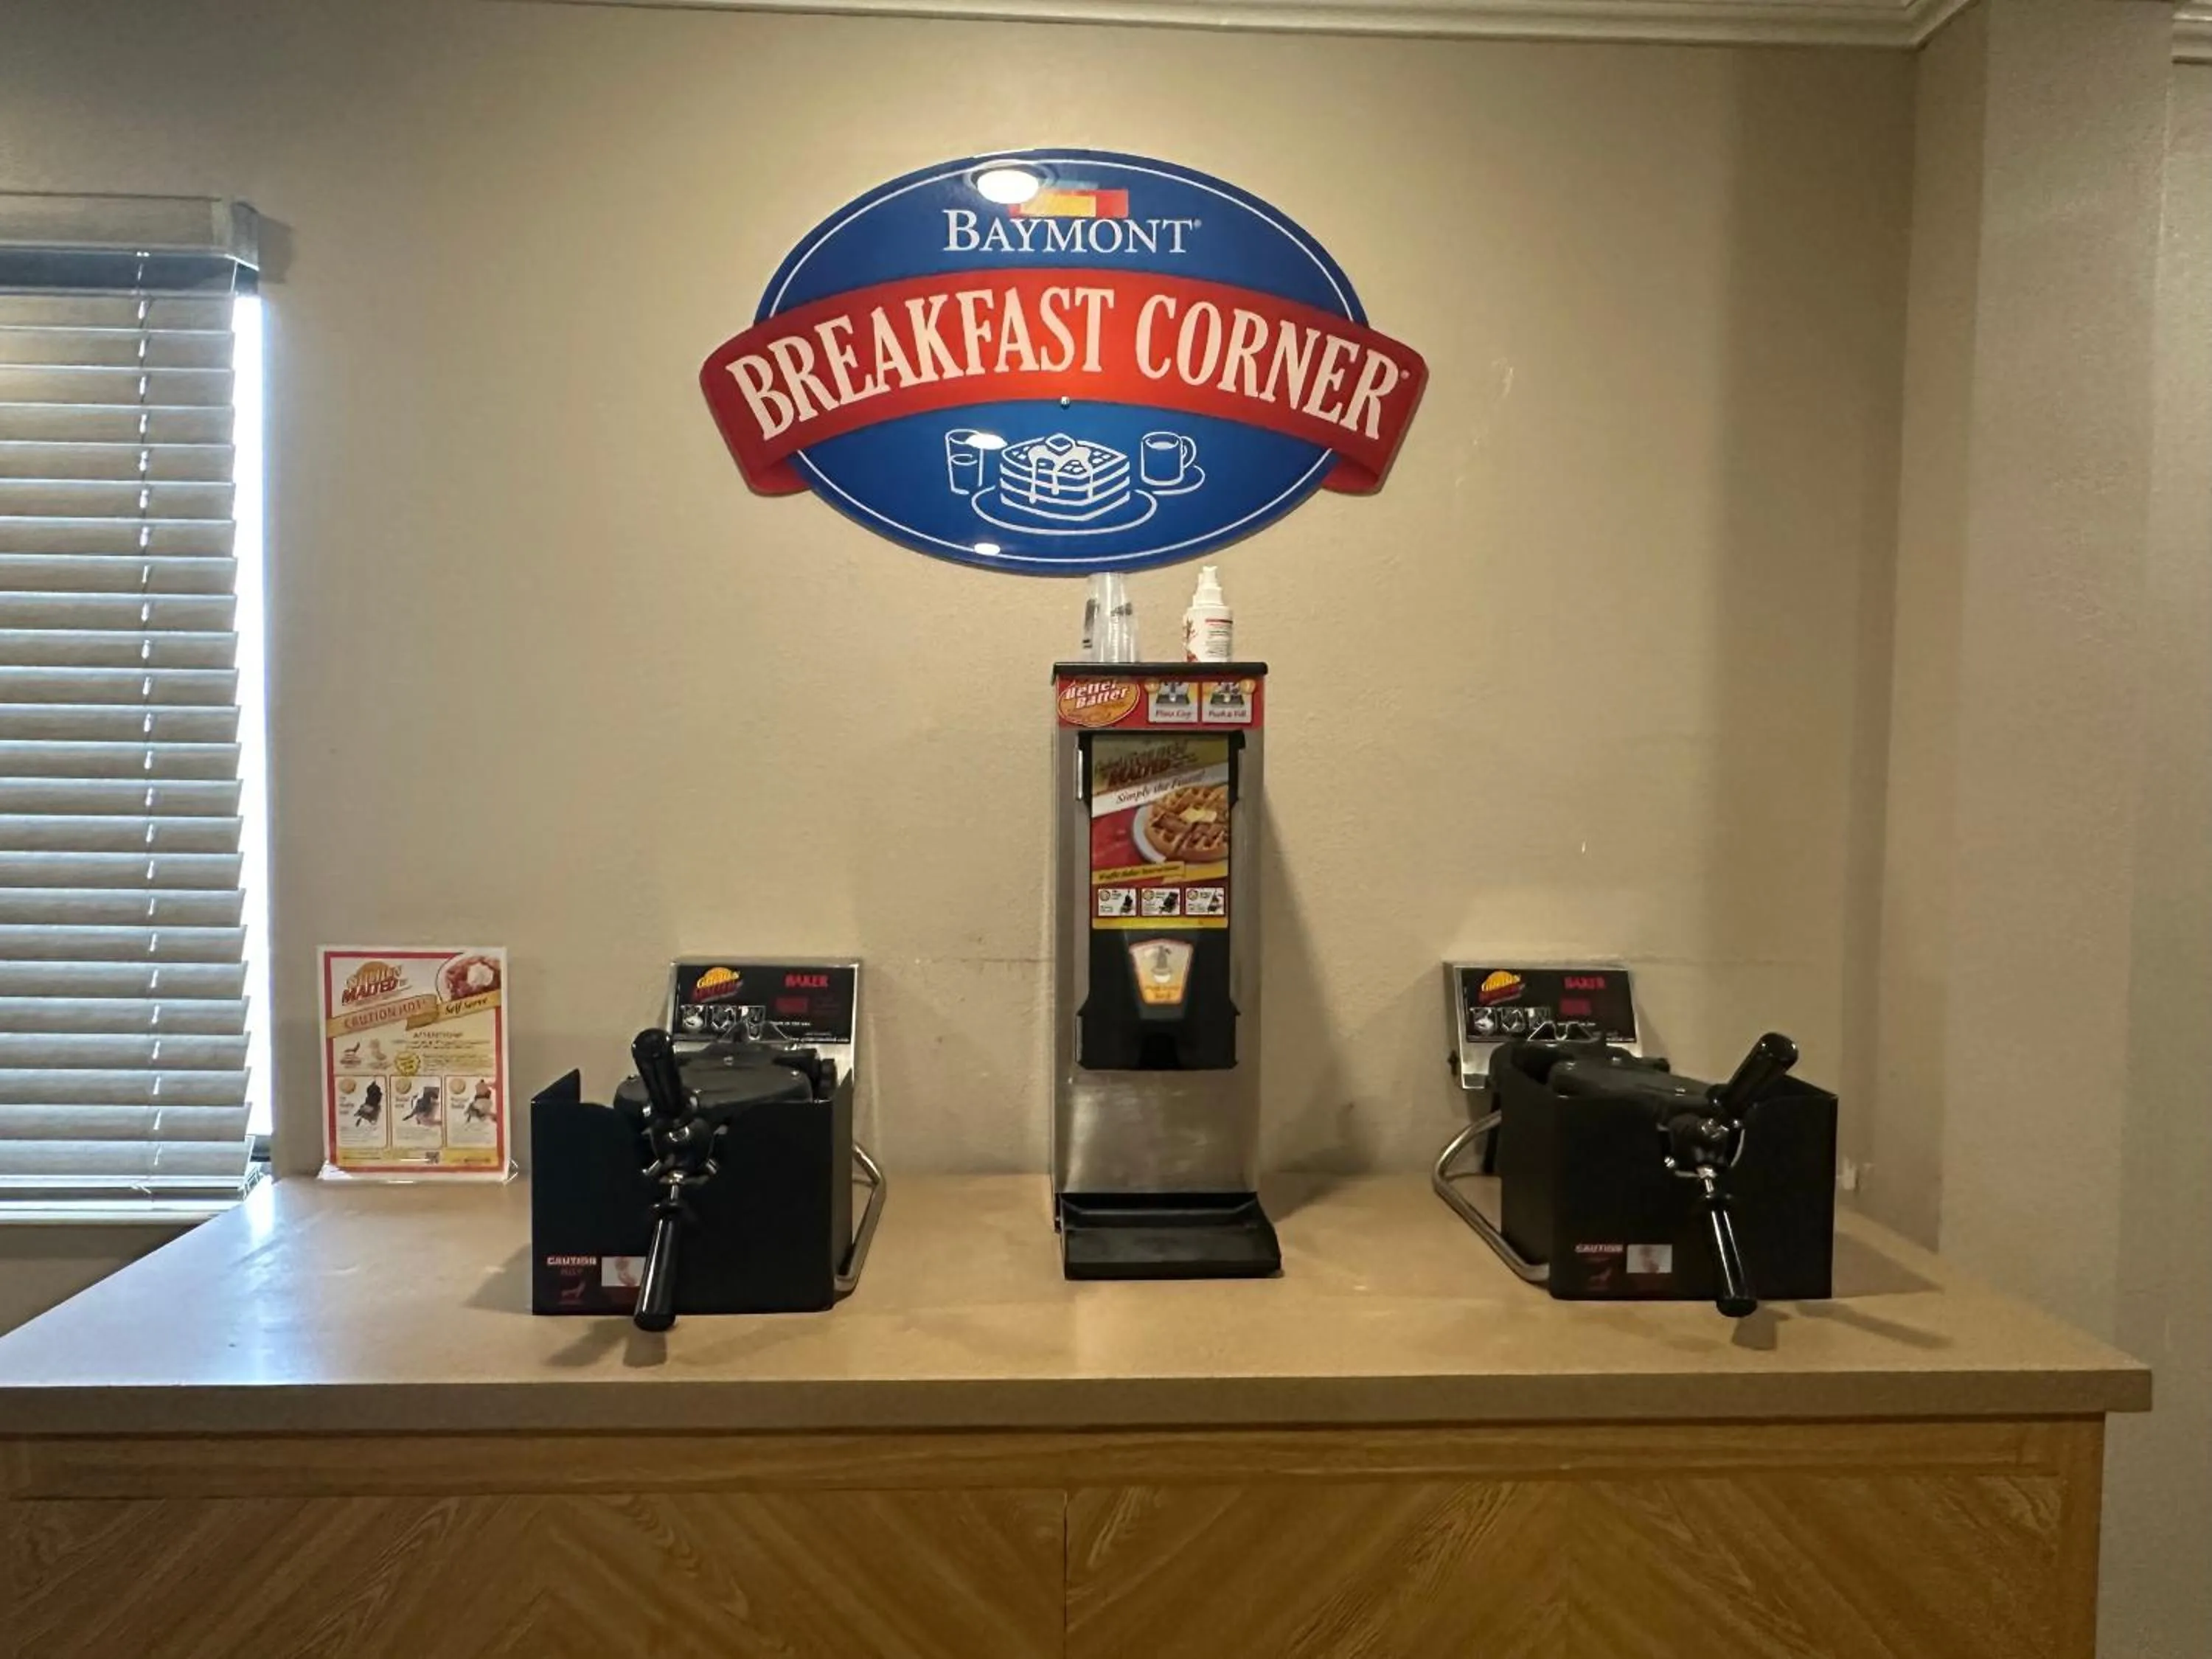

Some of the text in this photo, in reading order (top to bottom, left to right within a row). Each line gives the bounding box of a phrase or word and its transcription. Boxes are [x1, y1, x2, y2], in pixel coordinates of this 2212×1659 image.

[943, 209, 1194, 254] BAYMONT
[726, 285, 1402, 441] BREAKFAST CORNER
